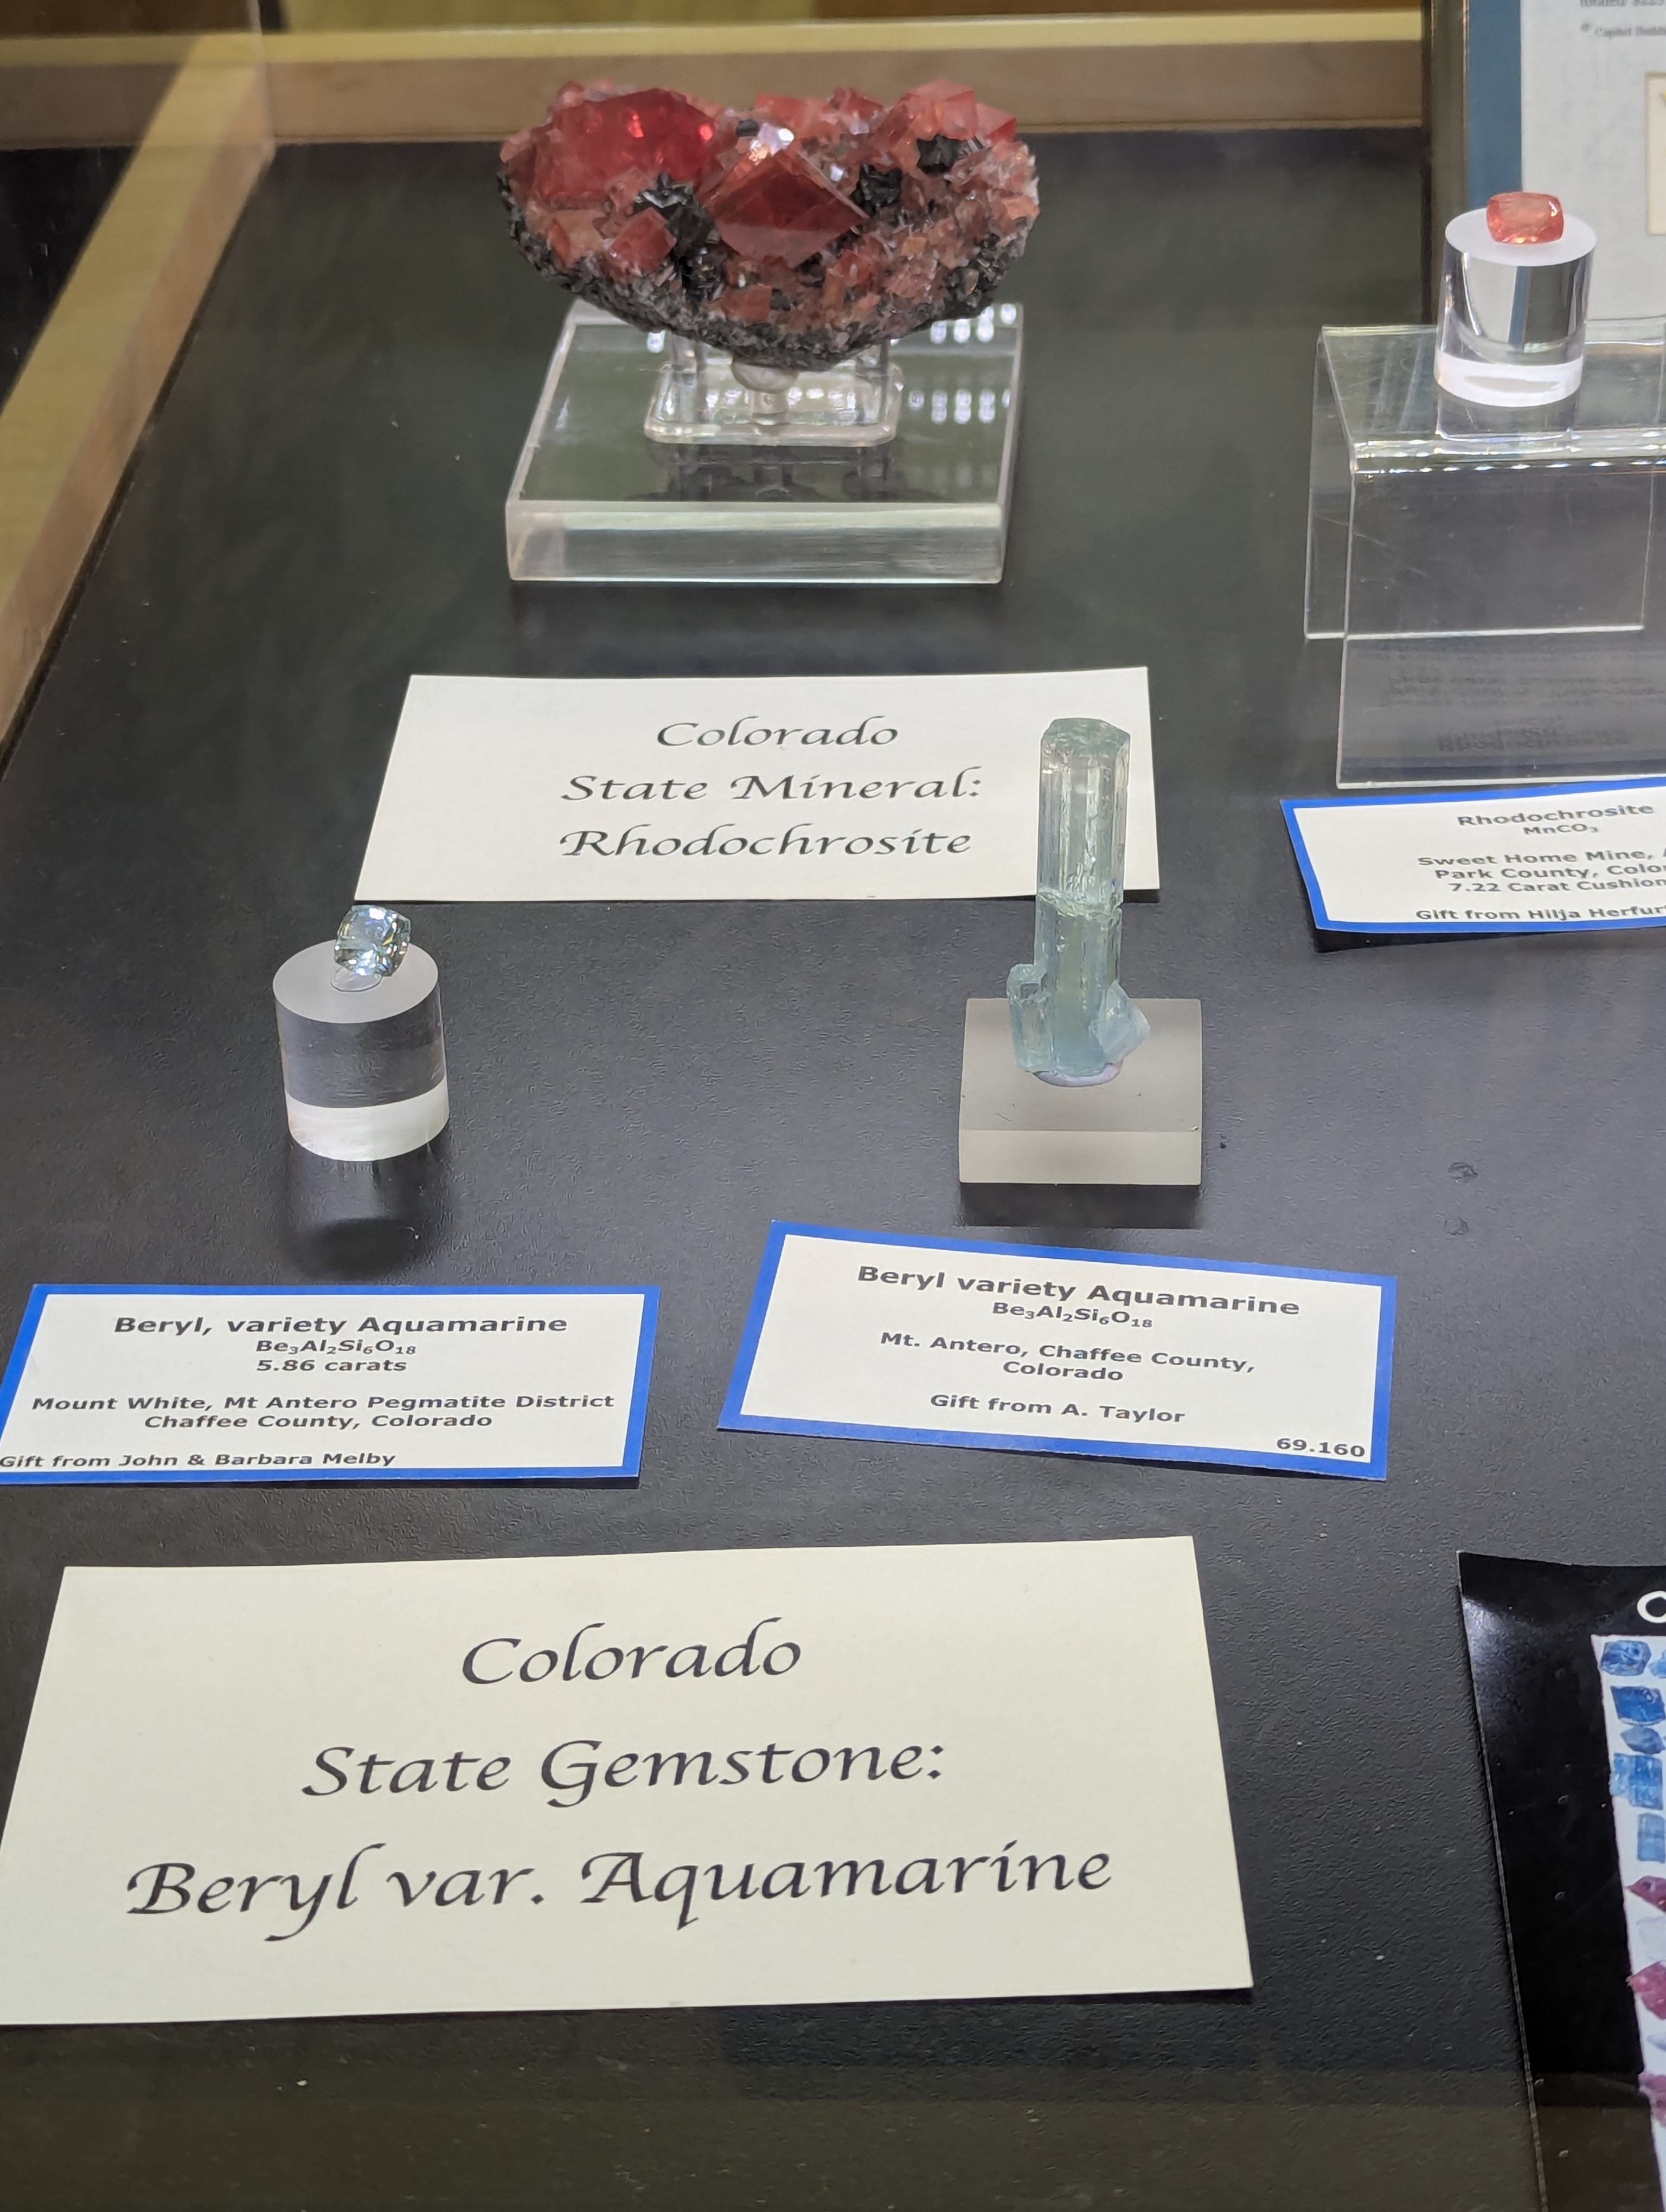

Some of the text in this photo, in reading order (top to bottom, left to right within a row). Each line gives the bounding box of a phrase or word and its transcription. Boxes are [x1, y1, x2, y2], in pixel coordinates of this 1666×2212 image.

[657, 715, 898, 747] Colorado
[561, 766, 982, 801] State Mineral:
[1457, 805, 1654, 826] Rhodochrosite
[559, 823, 971, 857] Rhodochrosite
[1417, 856, 1497, 866] Sweet
[1503, 854, 1578, 864] Home
[1585, 850, 1654, 861] Mine,
[1434, 869, 1494, 879] Park
[1501, 867, 1598, 879] County,
[1449, 878, 1666, 892] 7.22 Carat Cushion
[1415, 909, 1459, 920] Gift
[1464, 909, 1521, 919] from
[1528, 909, 1581, 921] Hilja
[857, 1265, 1300, 1315] Beryl variety Aquamarine
[114, 1316, 567, 1336] Beryl, variety Aquamarine
[880, 1332, 1254, 1373] Mt. Antero, Chaffee County,
[257, 1359, 407, 1372] 5.86 carats
[1003, 1361, 1123, 1381] Colorado
[31, 1394, 614, 1412] Mount White, Mt Antero Pegmatite District
[930, 1394, 1186, 1423] Gift from A. Taylor
[144, 1414, 492, 1430] Chaffee County, Colorado
[1276, 1437, 1366, 1458] 69.160
[0, 1452, 396, 1468] Gift from John & Barbara Melby
[462, 1617, 801, 1684] Colorado
[301, 1740, 944, 1808] State Gemstone:
[126, 1840, 1111, 1942] Beryl var. Aquamarine
